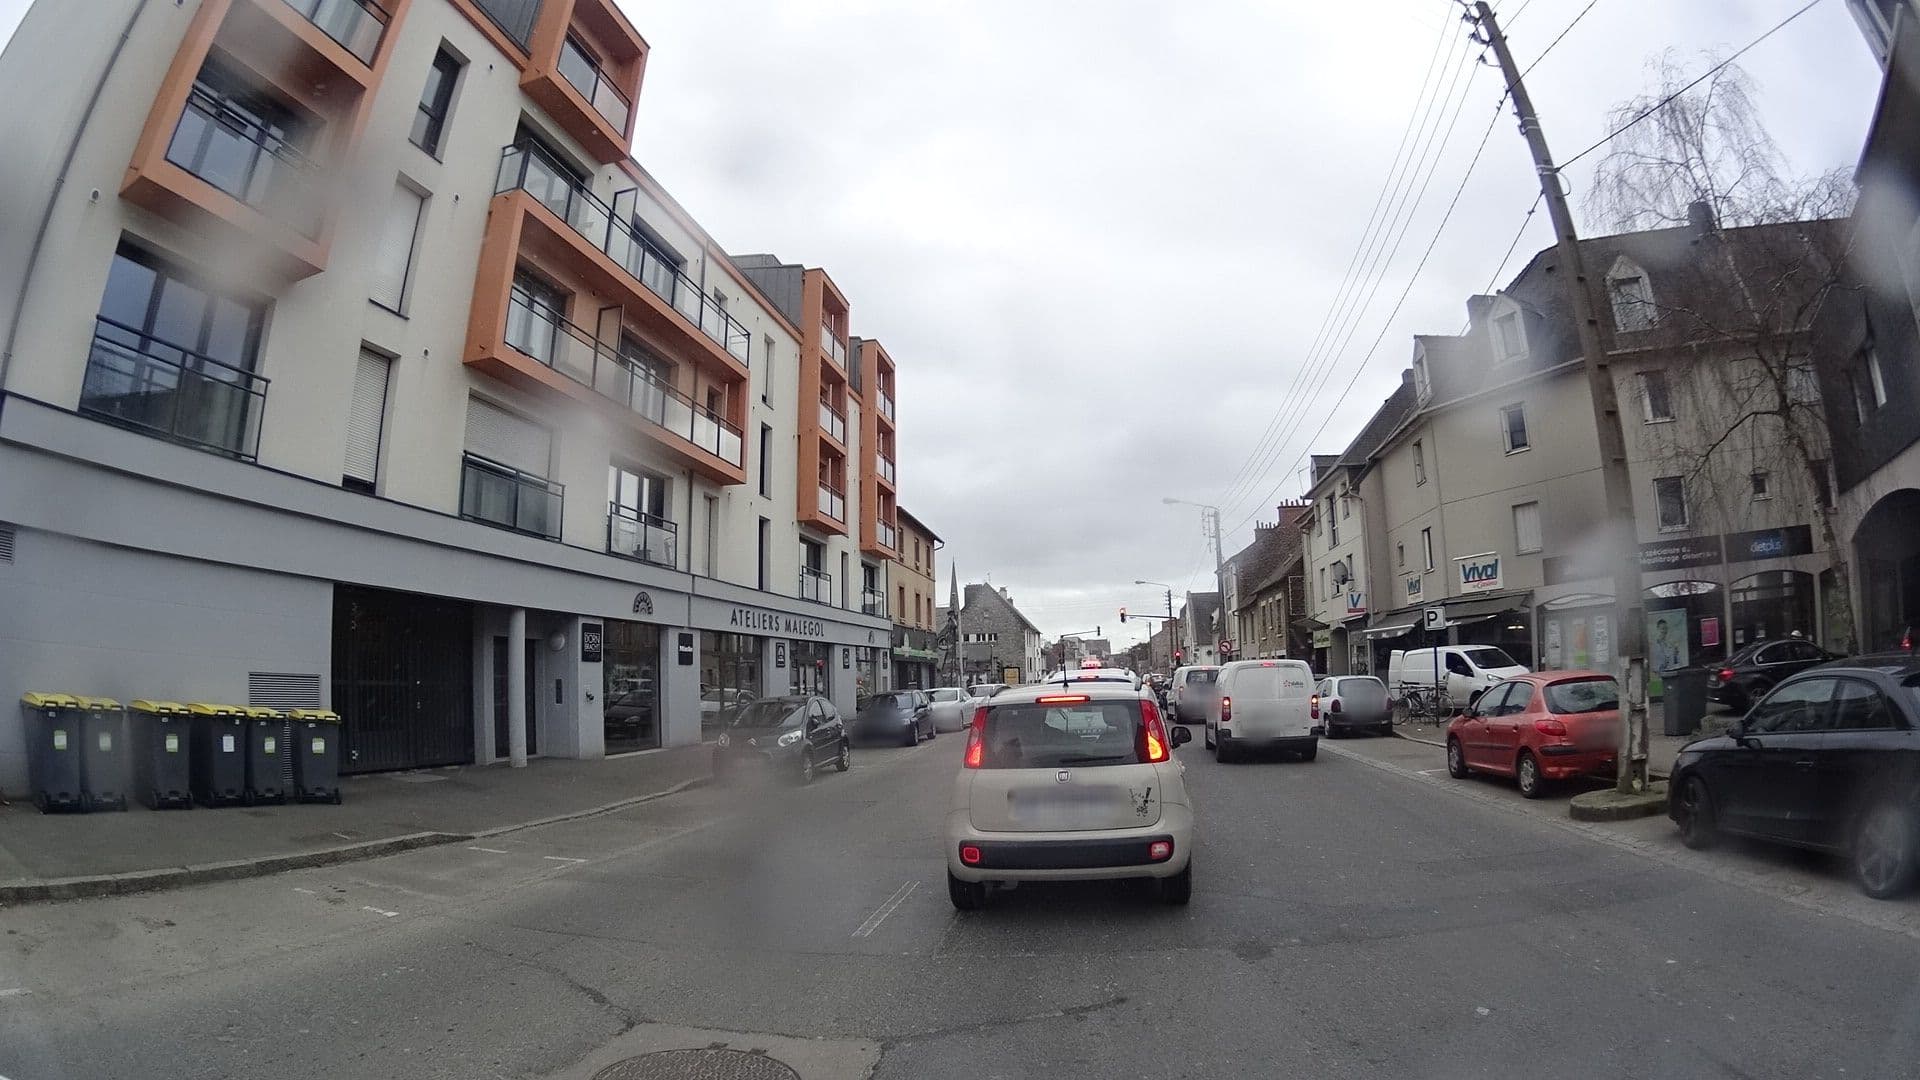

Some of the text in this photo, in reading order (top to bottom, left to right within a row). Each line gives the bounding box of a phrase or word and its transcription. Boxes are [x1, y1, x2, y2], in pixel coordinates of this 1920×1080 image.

[730, 607, 825, 637] ATELIERS MALEGOL
[1426, 610, 1438, 627] P
[584, 634, 600, 644] DORN
